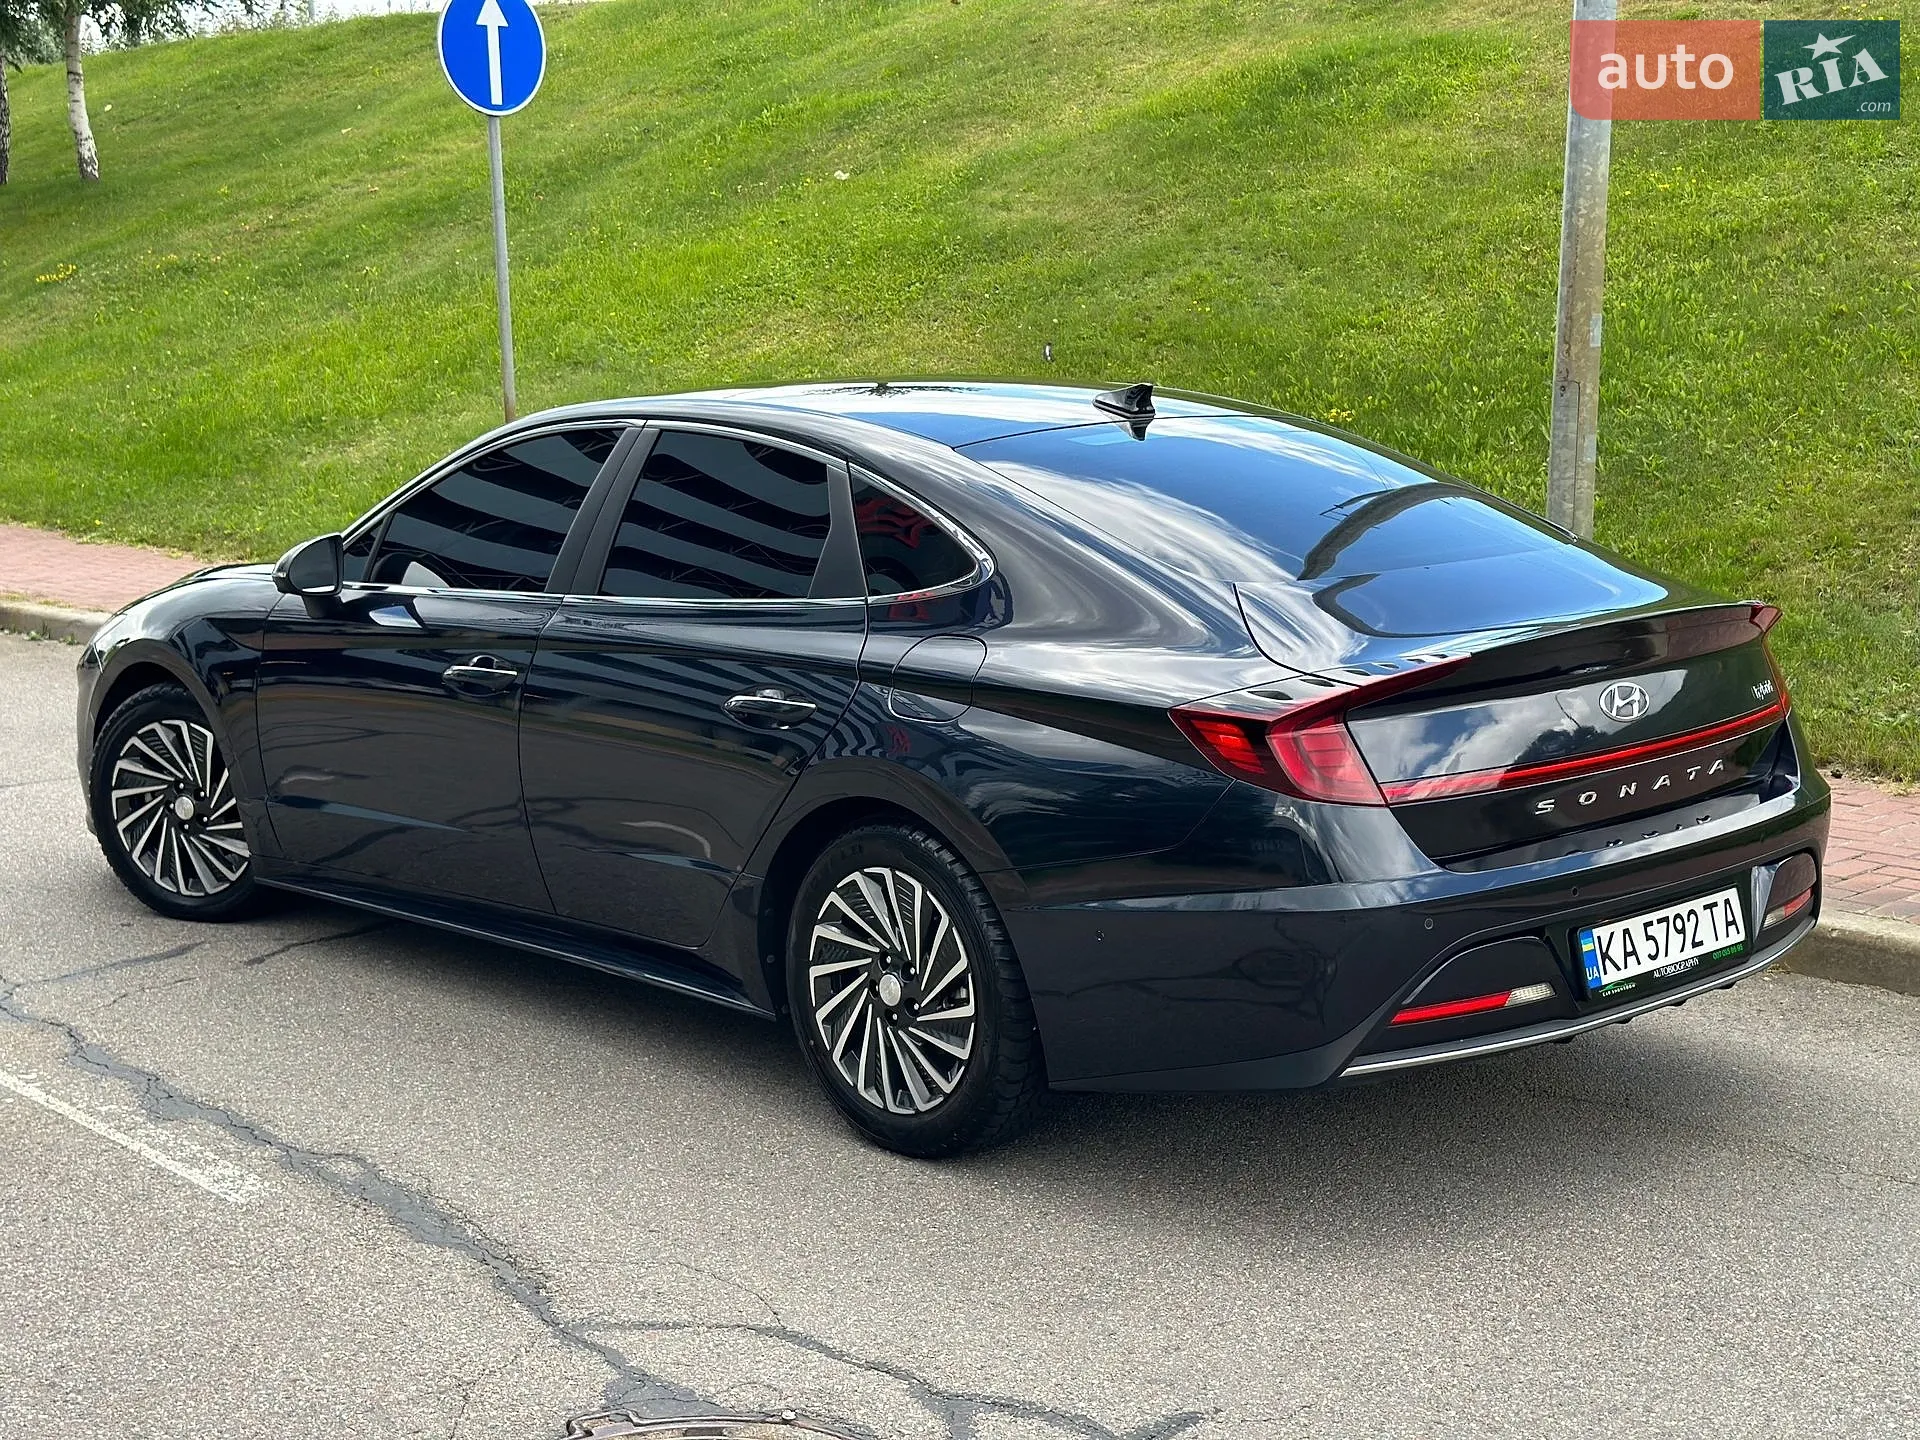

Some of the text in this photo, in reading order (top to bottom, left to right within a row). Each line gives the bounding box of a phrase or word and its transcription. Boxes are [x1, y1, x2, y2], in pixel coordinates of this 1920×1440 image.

[1535, 759, 1724, 815] SONATA
[1597, 898, 1740, 975] KA 5792 TA
[1586, 966, 1600, 980] UA
[1653, 958, 1699, 978] AUTOBIOGRAPHY
